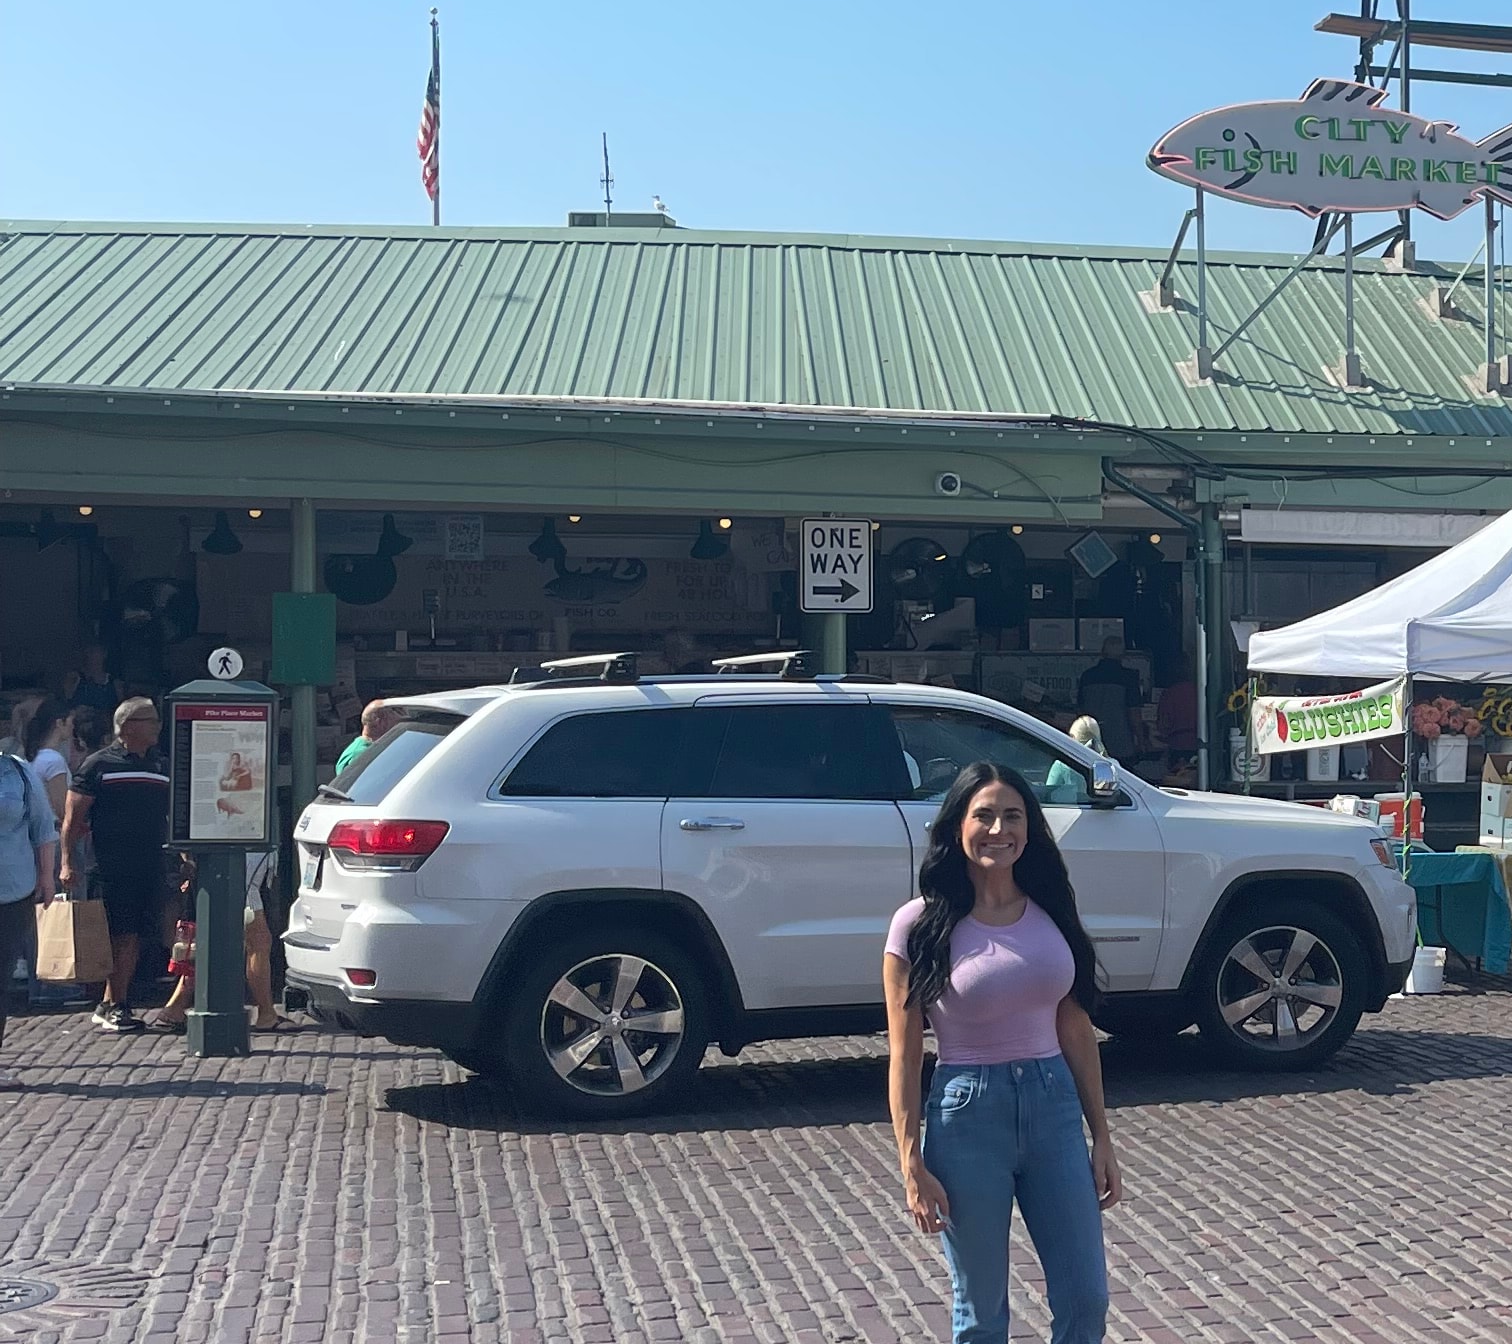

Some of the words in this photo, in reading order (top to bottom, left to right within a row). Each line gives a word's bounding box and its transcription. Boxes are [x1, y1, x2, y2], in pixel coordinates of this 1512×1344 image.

[1294, 114, 1413, 145] CITY
[1194, 146, 1298, 176] FISH
[1318, 151, 1504, 187] MARKET
[811, 527, 863, 549] ONE
[425, 559, 510, 573] ANYWHERE
[810, 552, 865, 575] WAY
[442, 572, 460, 585] IN
[465, 572, 493, 585] THE
[564, 608, 593, 618] FISH
[1288, 693, 1393, 743] SLUSHIES
